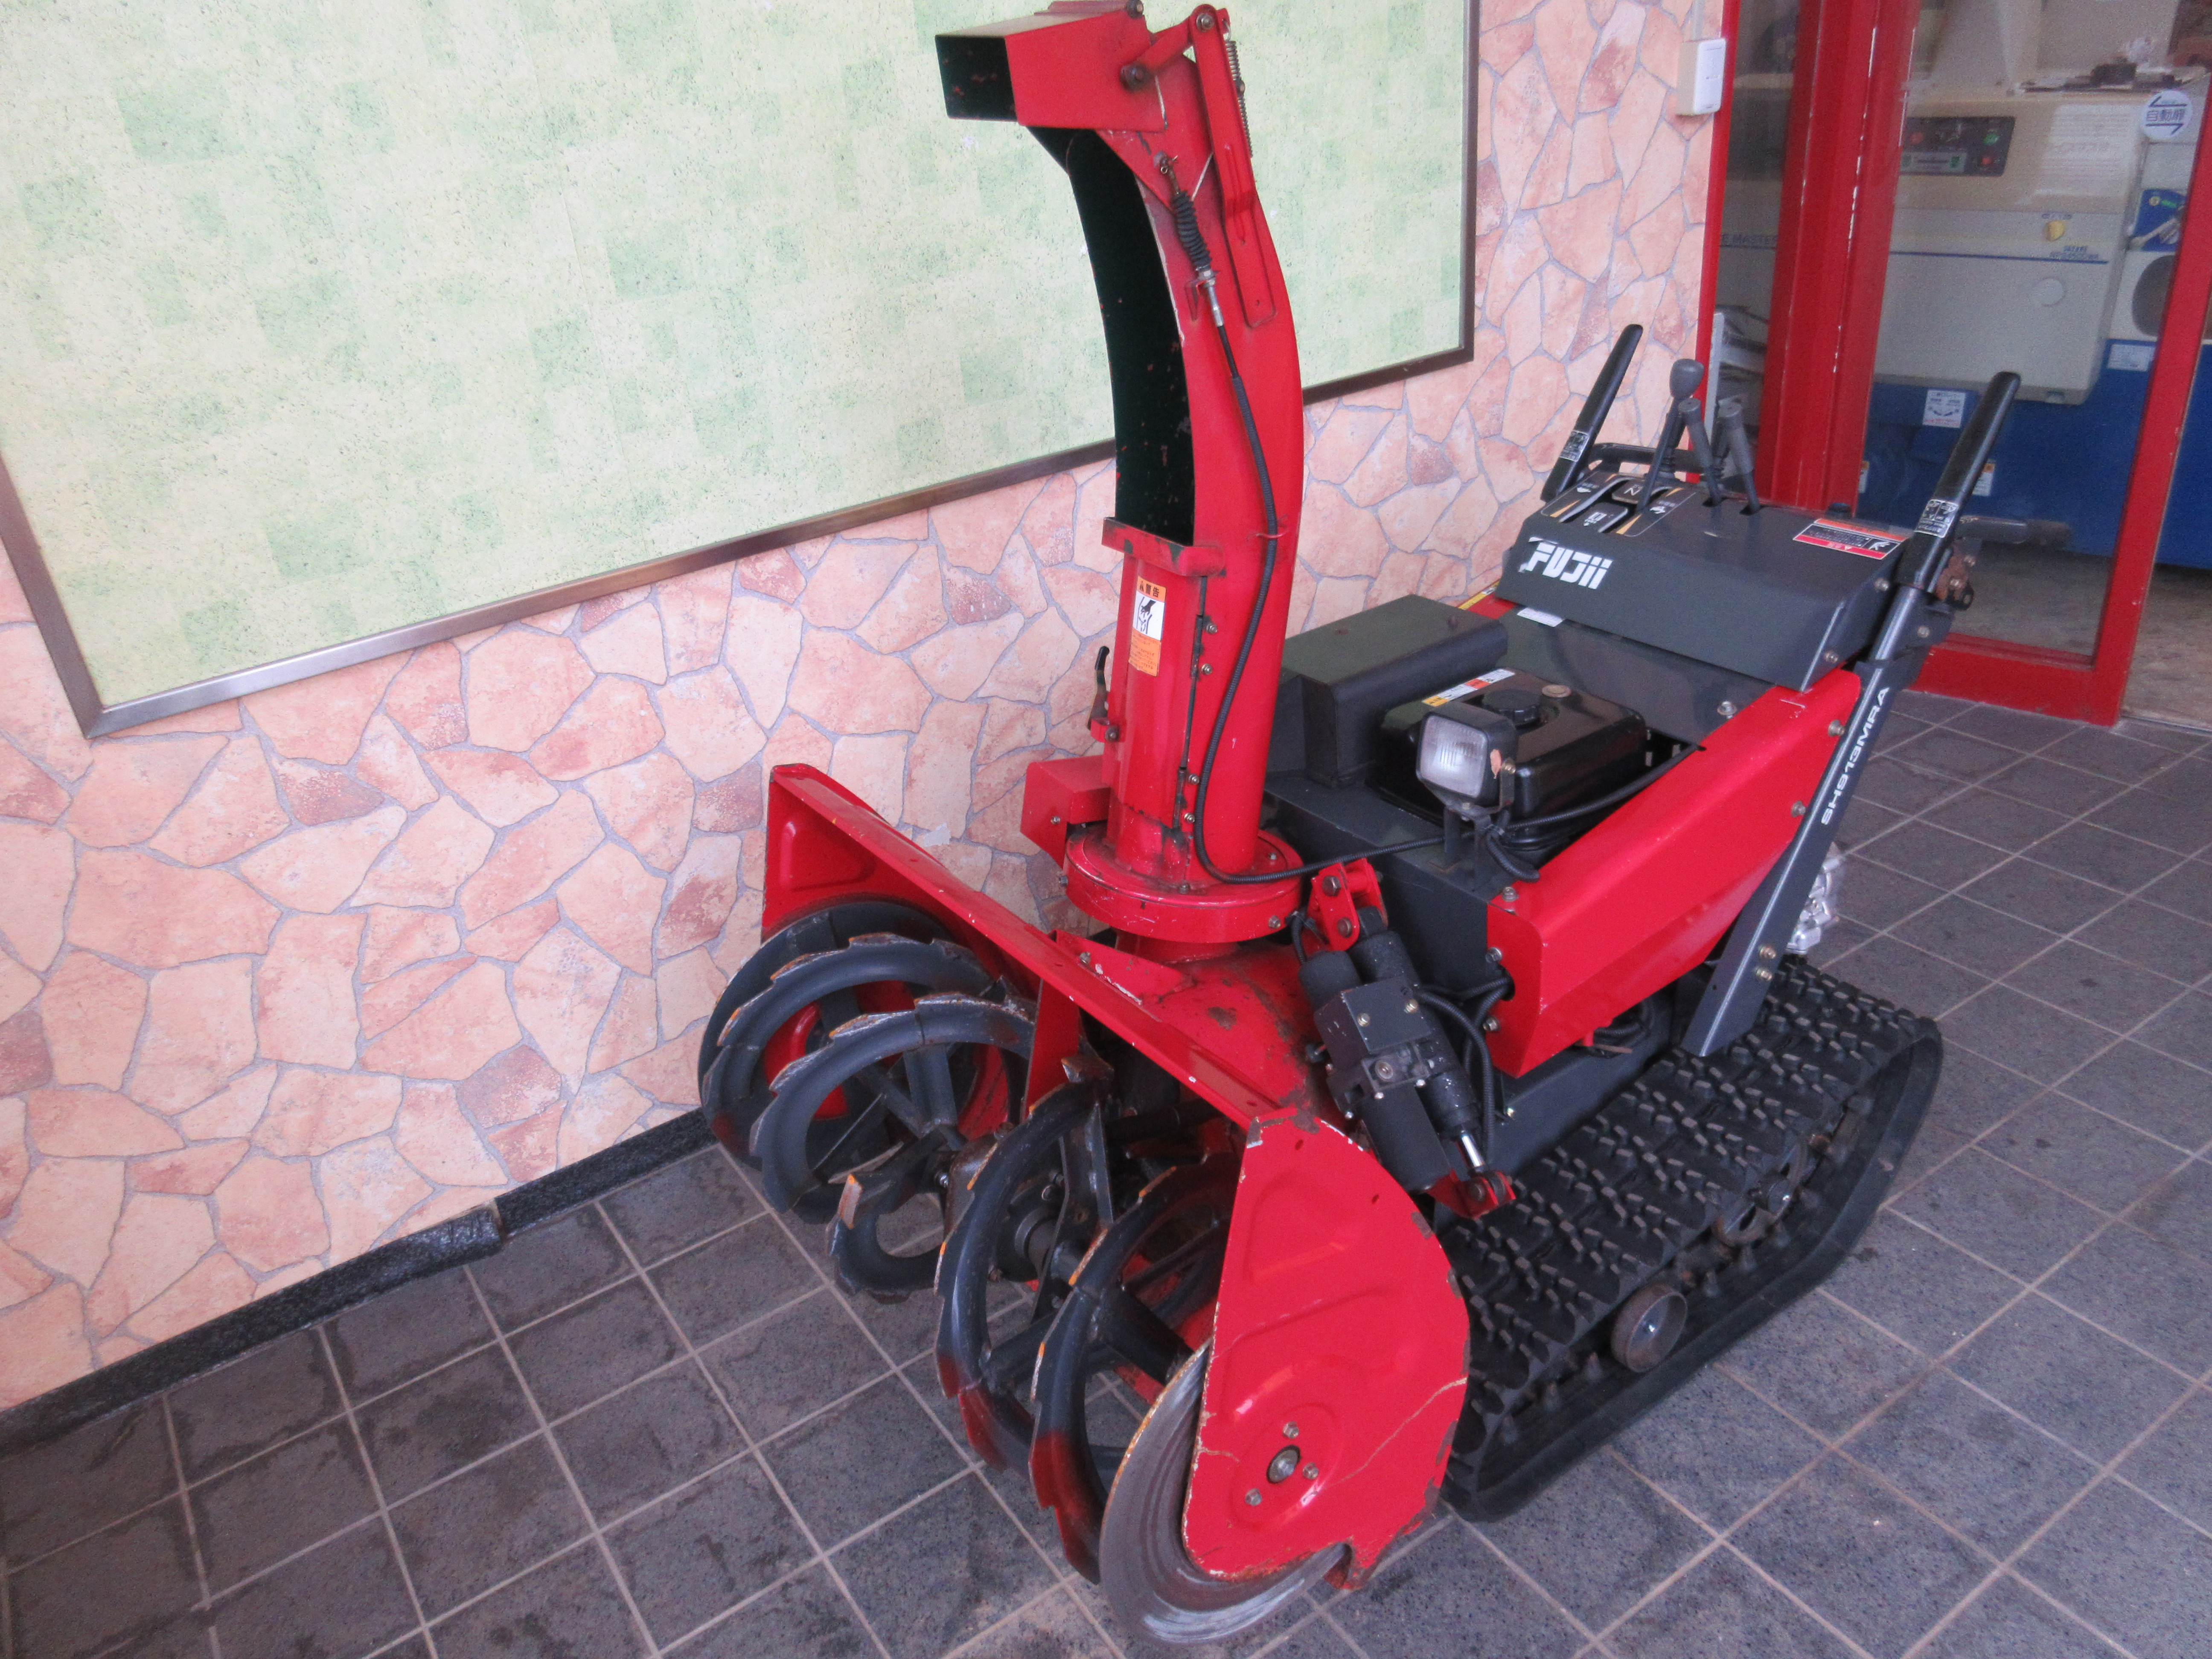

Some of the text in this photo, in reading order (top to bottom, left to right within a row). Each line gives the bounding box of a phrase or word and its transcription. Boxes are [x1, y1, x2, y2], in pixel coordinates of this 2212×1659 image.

[1524, 541, 1613, 590] FUJII
[1145, 583, 1159, 598] 警告
[1821, 687, 1890, 825] SH913MRA
